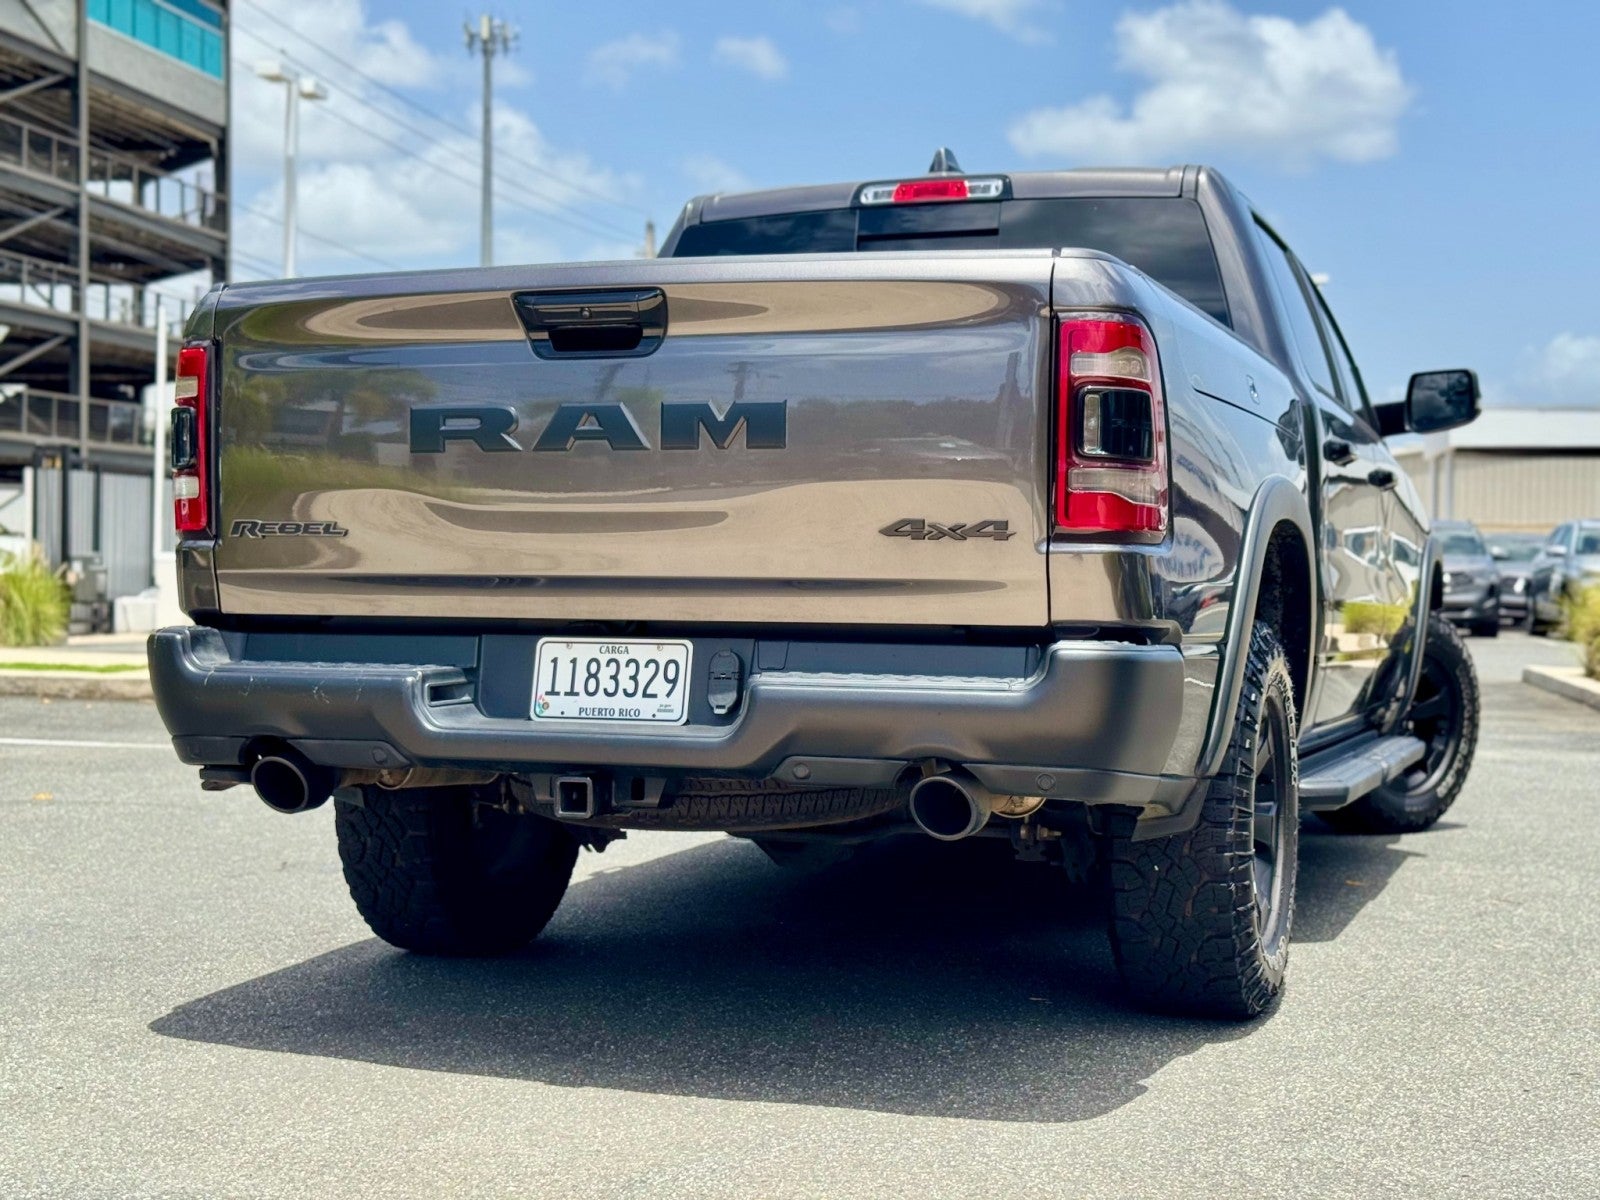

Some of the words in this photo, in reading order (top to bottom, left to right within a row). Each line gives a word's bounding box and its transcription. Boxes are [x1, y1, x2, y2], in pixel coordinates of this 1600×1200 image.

[410, 400, 787, 453] RAM
[229, 519, 349, 539] REBEL
[878, 517, 1017, 541] 4x4
[599, 645, 629, 655] CARGA
[545, 656, 680, 699] 1183329
[578, 707, 615, 717] PUERTO
[618, 708, 640, 718] RICO
